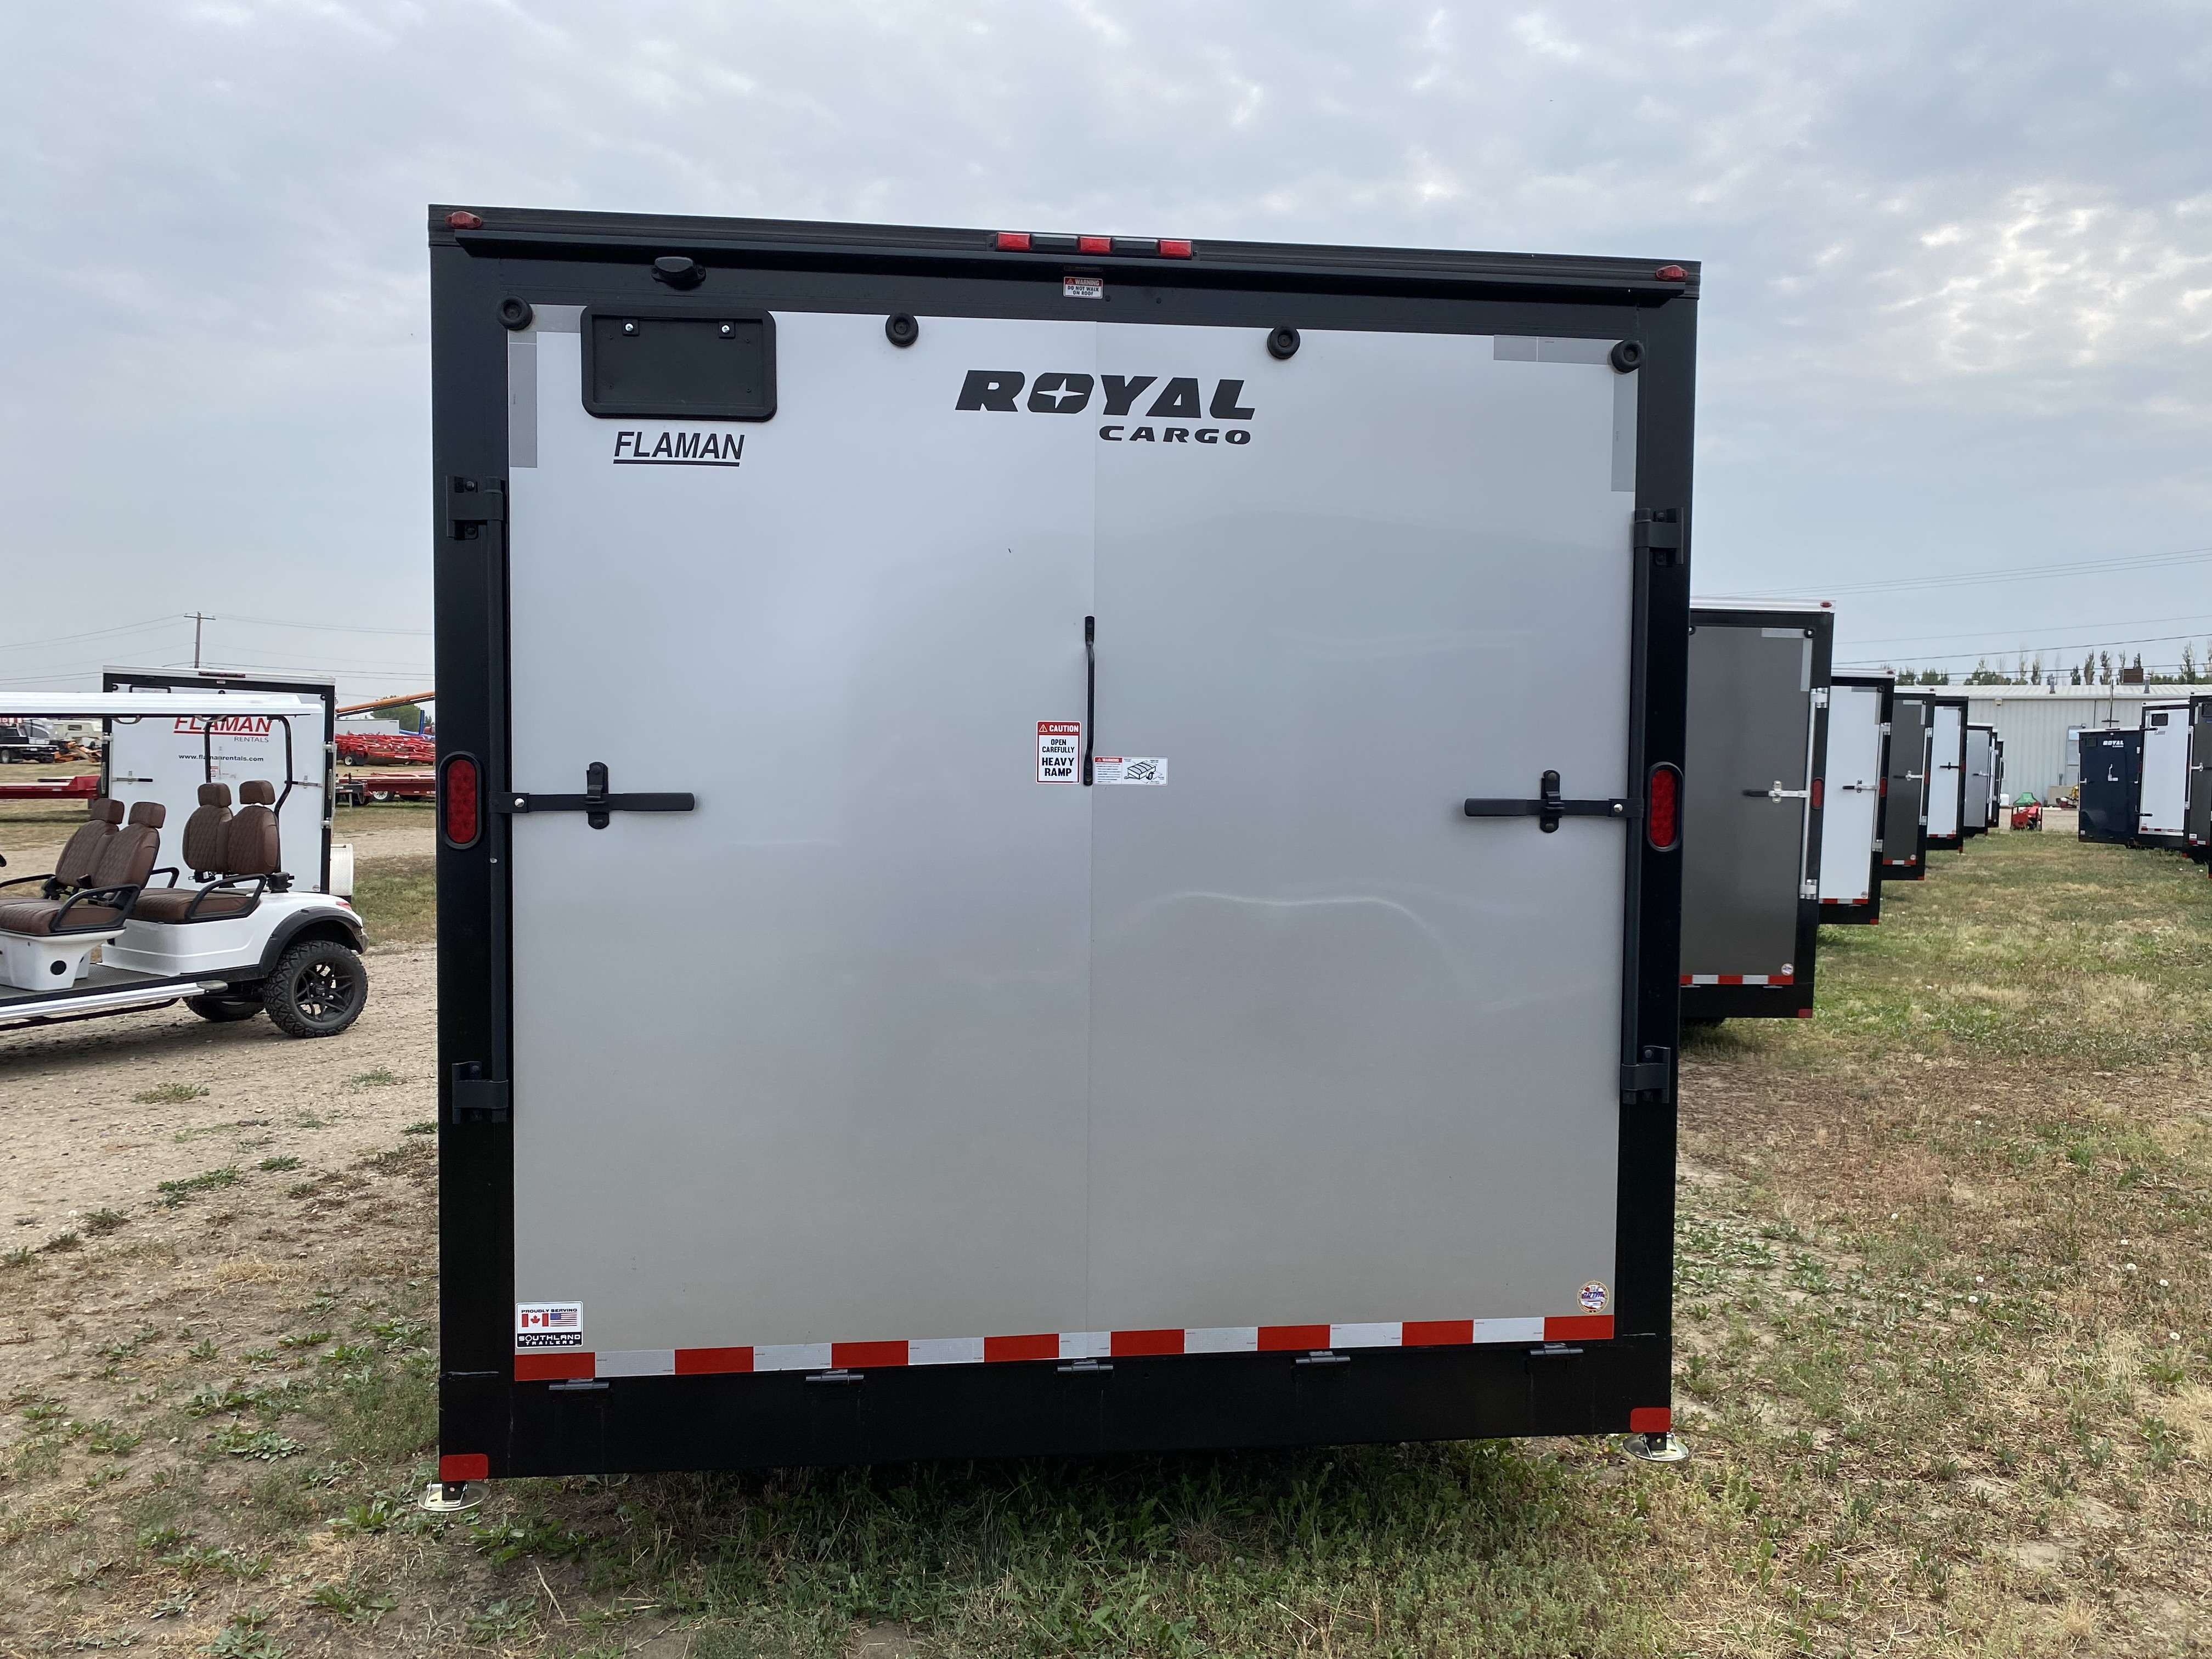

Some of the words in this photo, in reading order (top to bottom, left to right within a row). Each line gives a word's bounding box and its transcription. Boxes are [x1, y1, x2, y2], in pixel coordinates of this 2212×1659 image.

[955, 370, 1255, 420] ROYAL
[1099, 425, 1251, 445] CARGO
[614, 431, 745, 460] FLAMAN
[1042, 758, 1075, 766] HEAVY
[1045, 768, 1072, 776] RAMP
